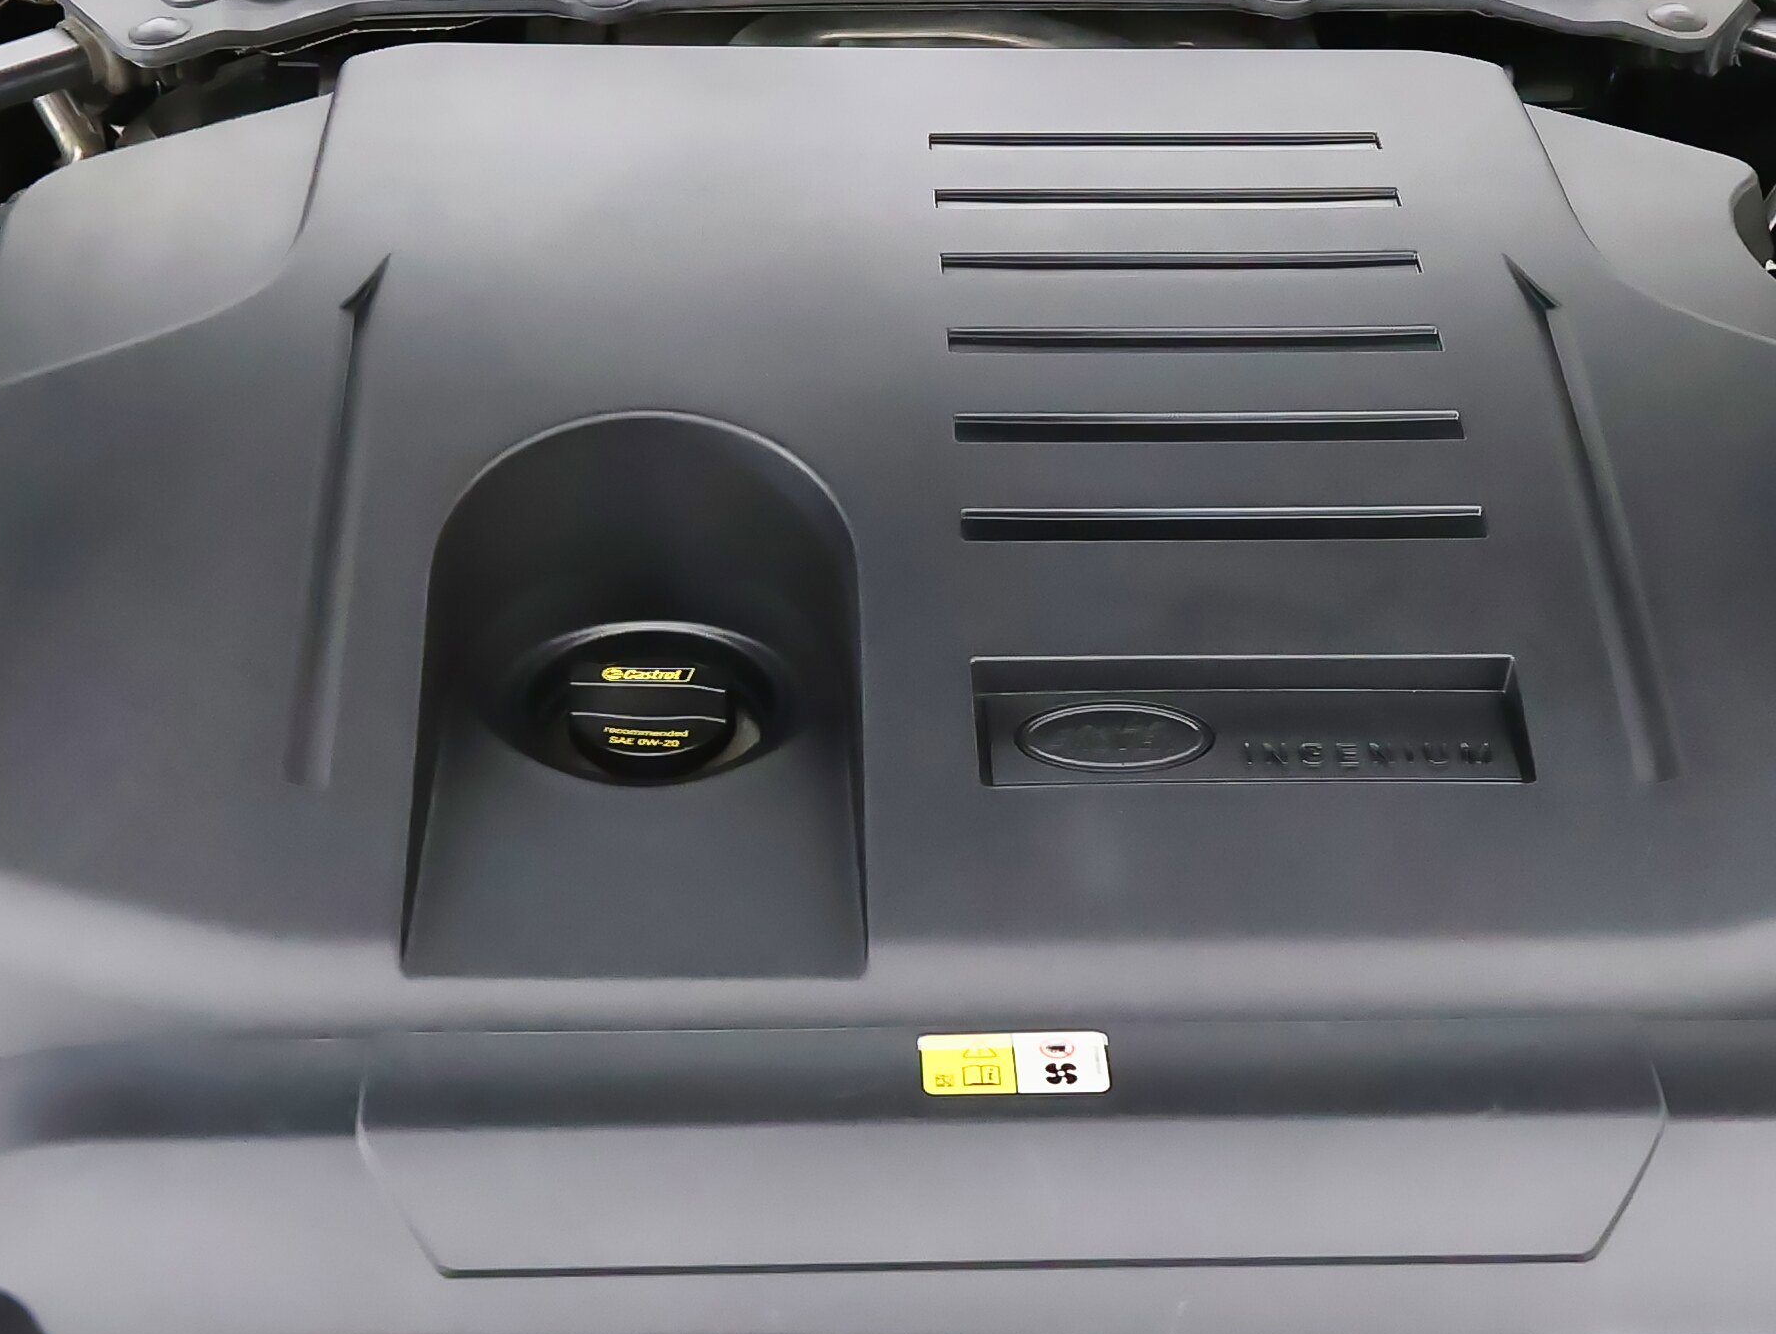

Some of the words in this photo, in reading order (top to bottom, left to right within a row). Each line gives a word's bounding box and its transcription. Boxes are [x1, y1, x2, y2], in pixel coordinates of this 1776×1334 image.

[623, 669, 682, 680] Castrol
[603, 727, 689, 738] recommended
[608, 735, 635, 745] SAE
[637, 738, 680, 748] 0W-20
[1243, 741, 1493, 767] INGENIUM
